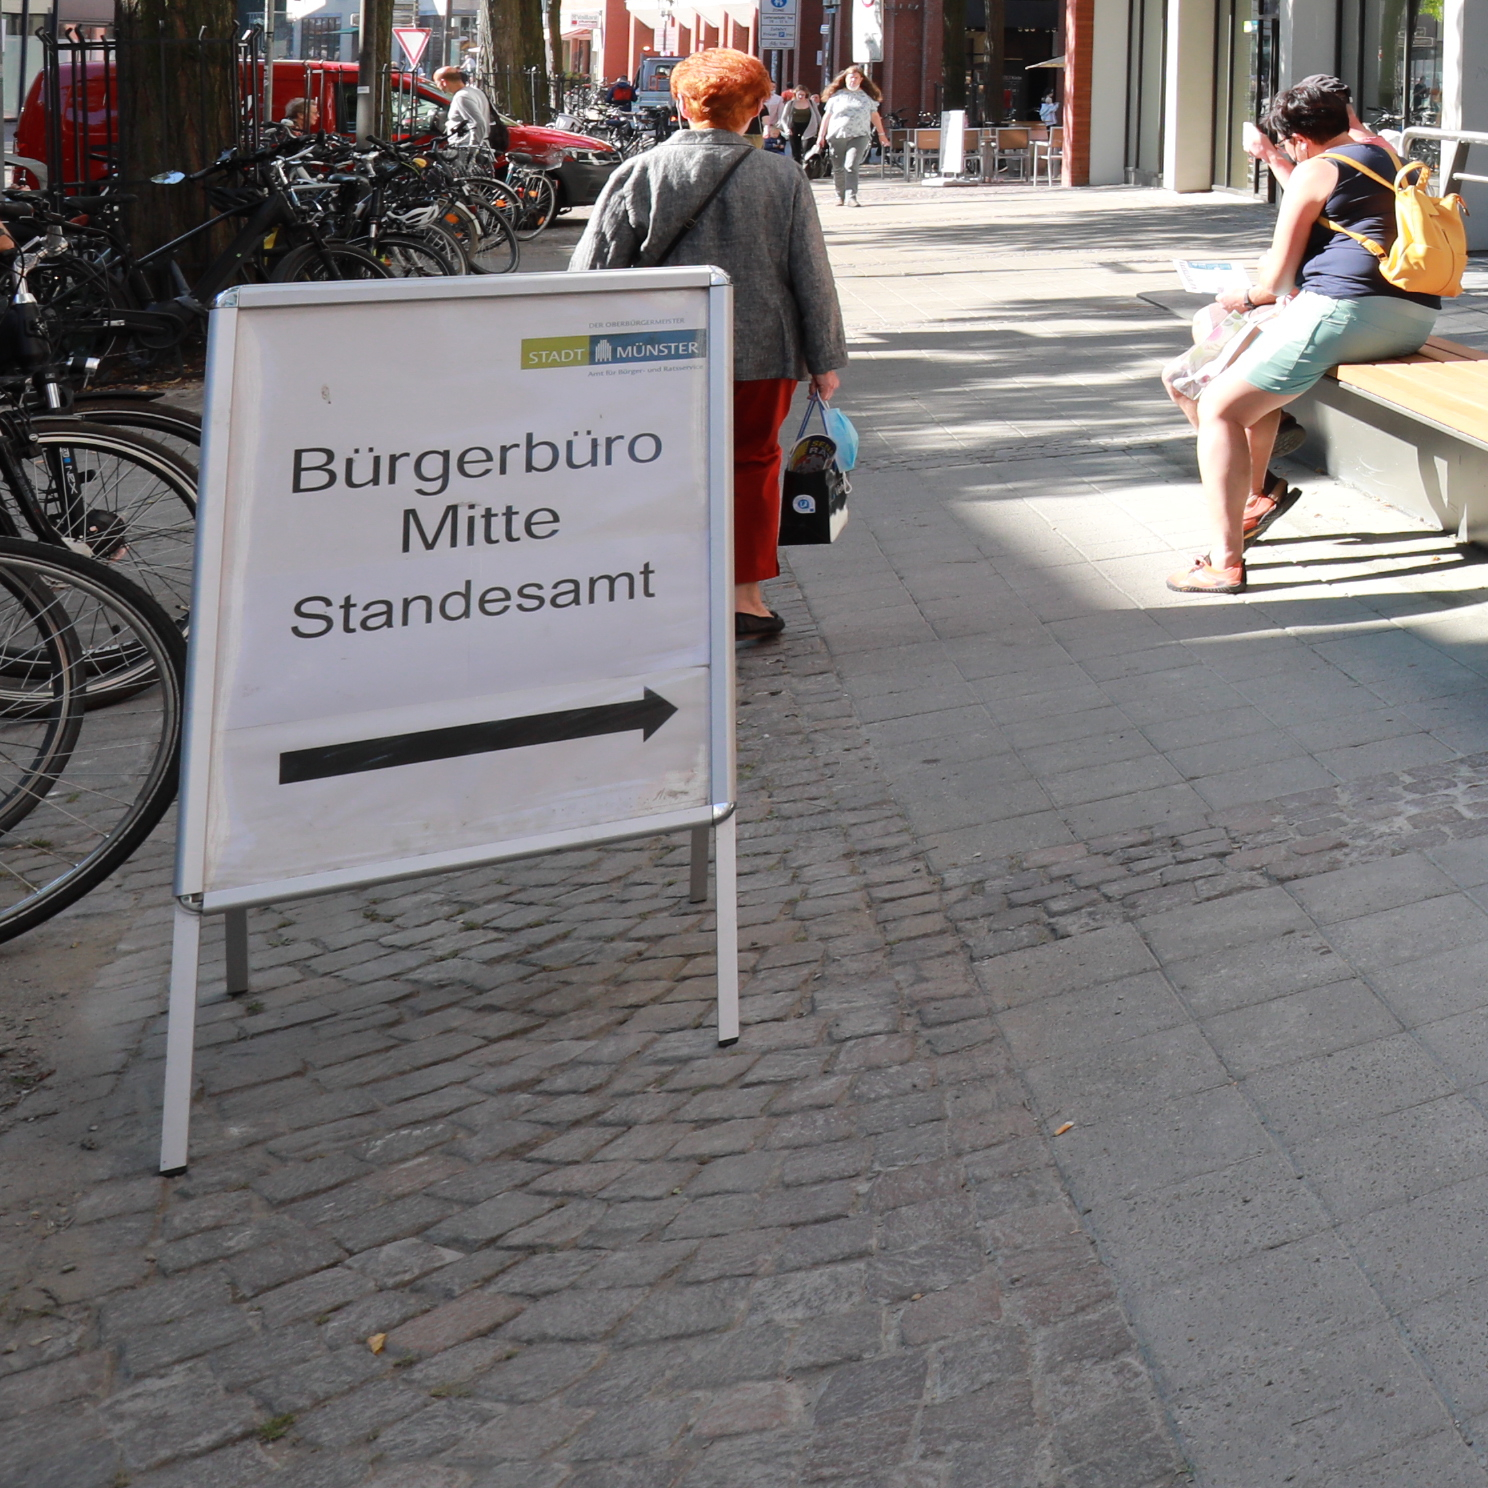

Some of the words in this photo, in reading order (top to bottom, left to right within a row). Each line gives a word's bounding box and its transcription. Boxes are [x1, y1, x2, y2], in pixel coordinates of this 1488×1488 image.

[605, 317, 685, 328] OBERBÜRGERMEISTER
[528, 348, 586, 364] STADT
[616, 341, 699, 359] MÜNSTER
[606, 369, 617, 377] für
[618, 368, 646, 377] Bürger-
[663, 364, 704, 372] Ratsservice
[291, 428, 664, 496] Bürgerbüro
[401, 503, 561, 554] Mitte
[290, 560, 657, 640] Standesamt
